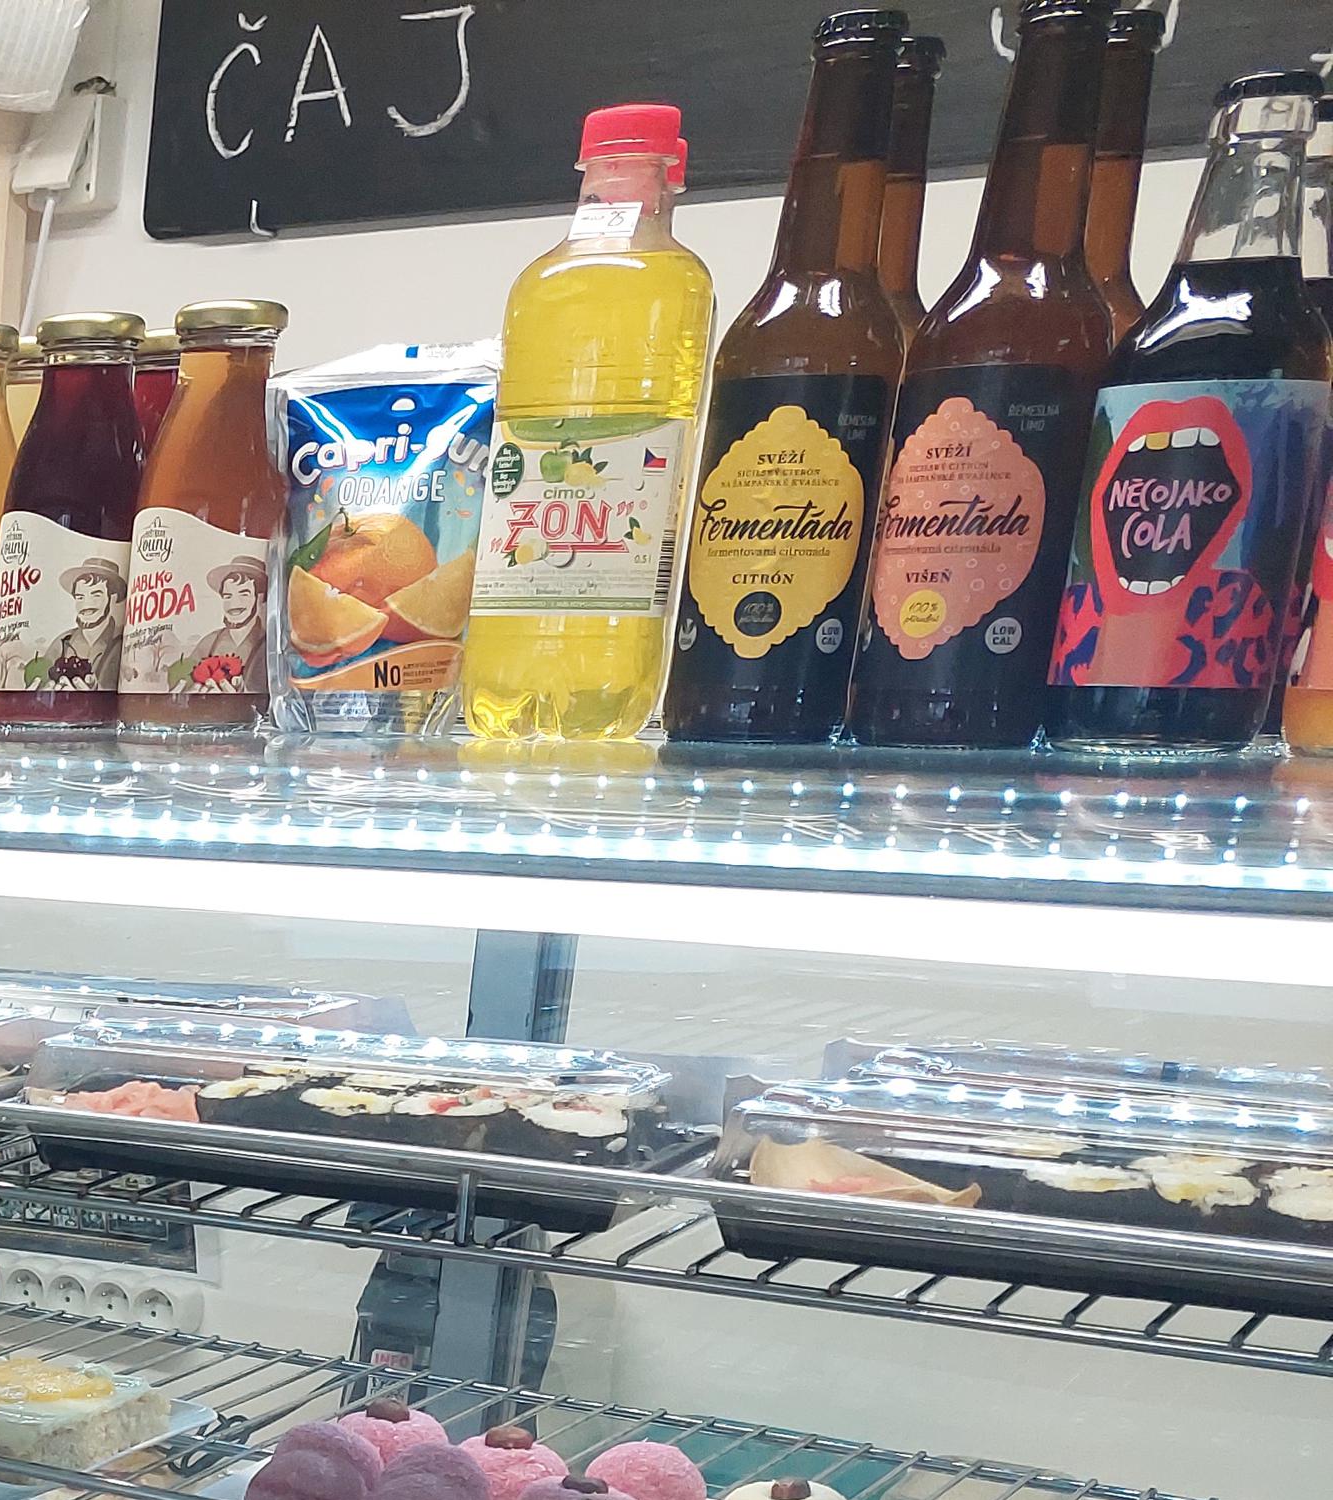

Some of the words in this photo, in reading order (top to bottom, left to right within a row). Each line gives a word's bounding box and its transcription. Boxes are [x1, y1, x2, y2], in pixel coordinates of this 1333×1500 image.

[205, 6, 476, 160] ČAJ
[337, 469, 446, 507] ORANGE
[1121, 511, 1192, 557] COLA
[373, 660, 401, 688] No
